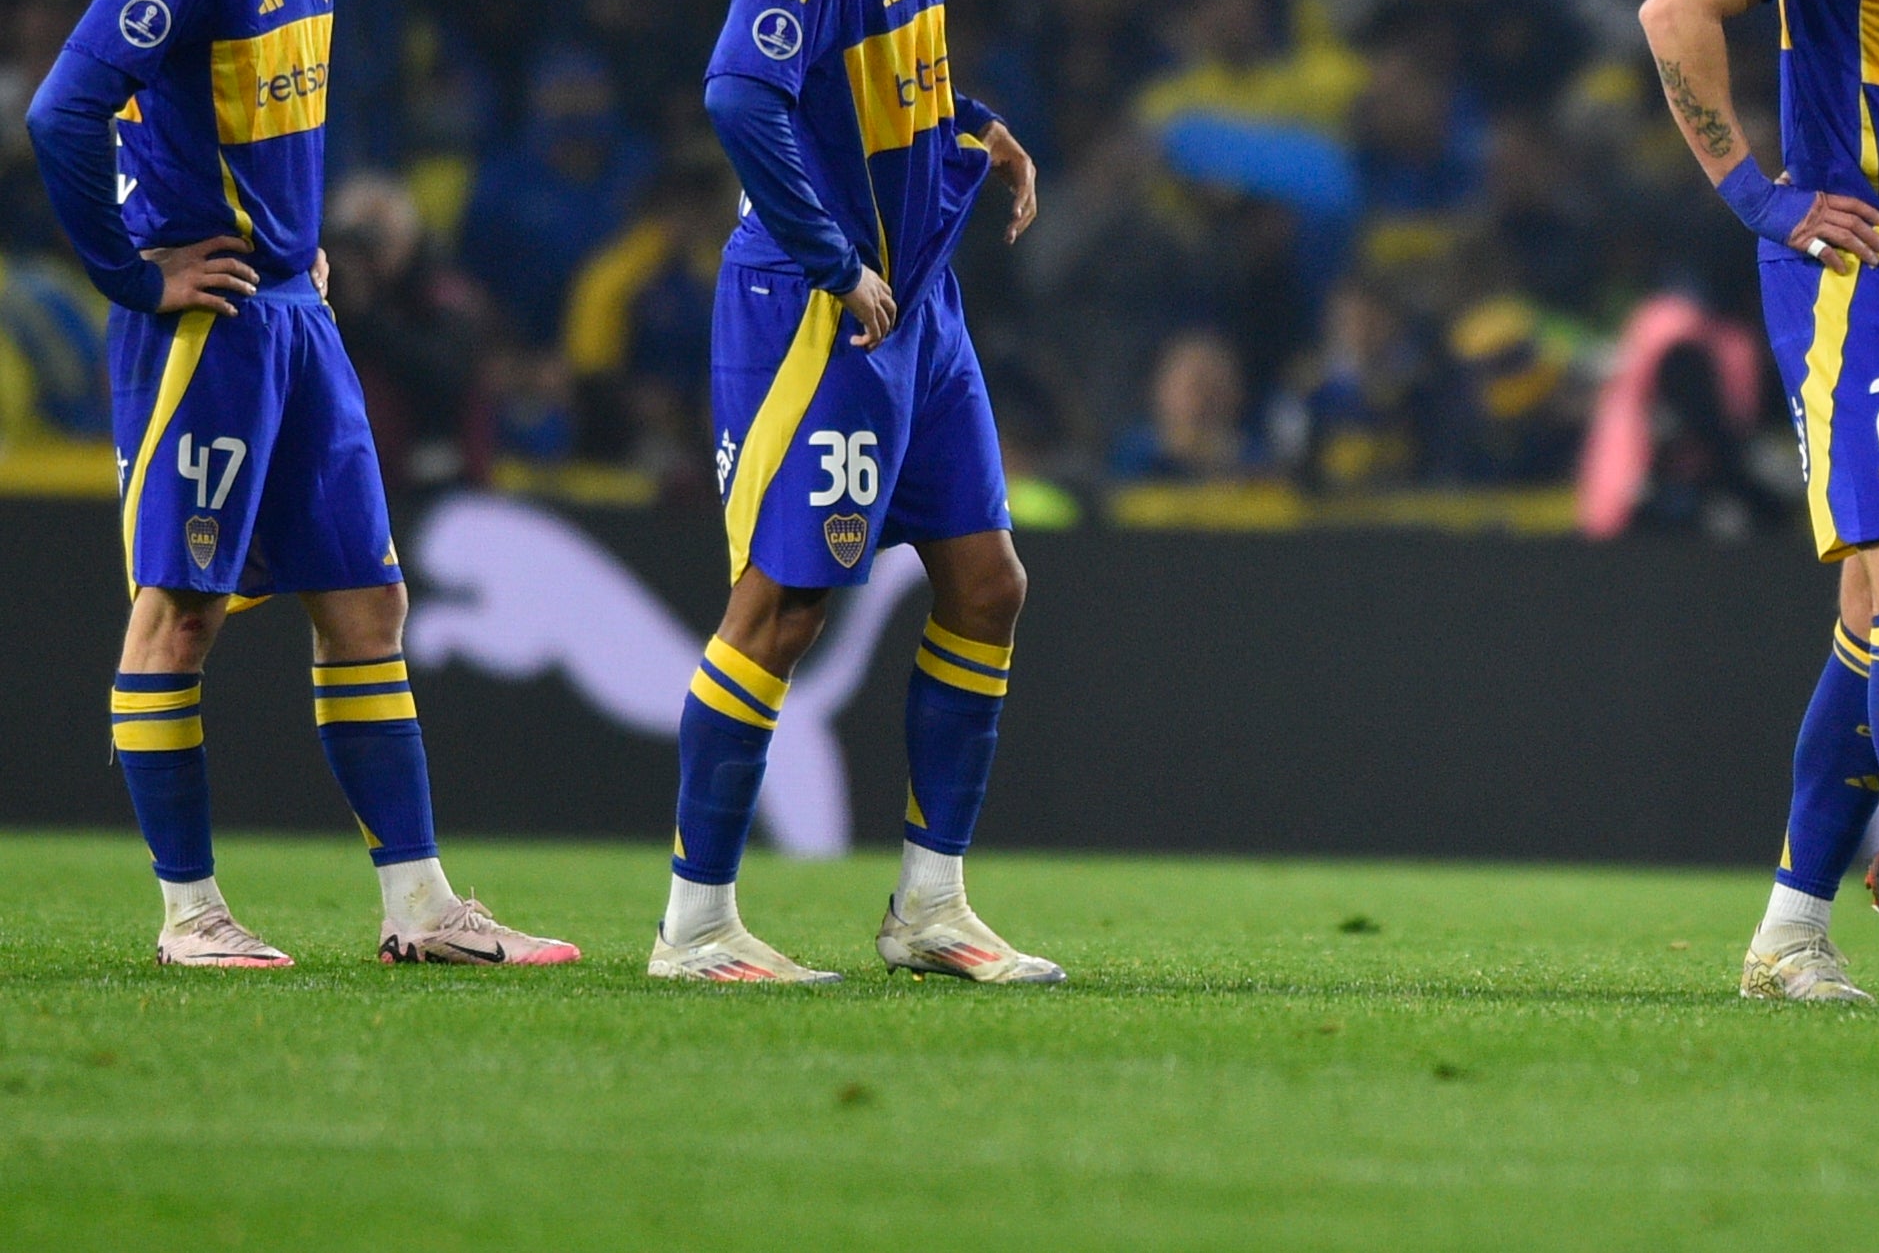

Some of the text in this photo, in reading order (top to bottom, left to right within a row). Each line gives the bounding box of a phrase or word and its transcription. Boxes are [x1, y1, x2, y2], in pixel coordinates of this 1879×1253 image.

[177, 432, 247, 509] 47
[808, 430, 878, 506] 36
[190, 532, 215, 545] CABJ
[830, 532, 862, 544] CABJ
